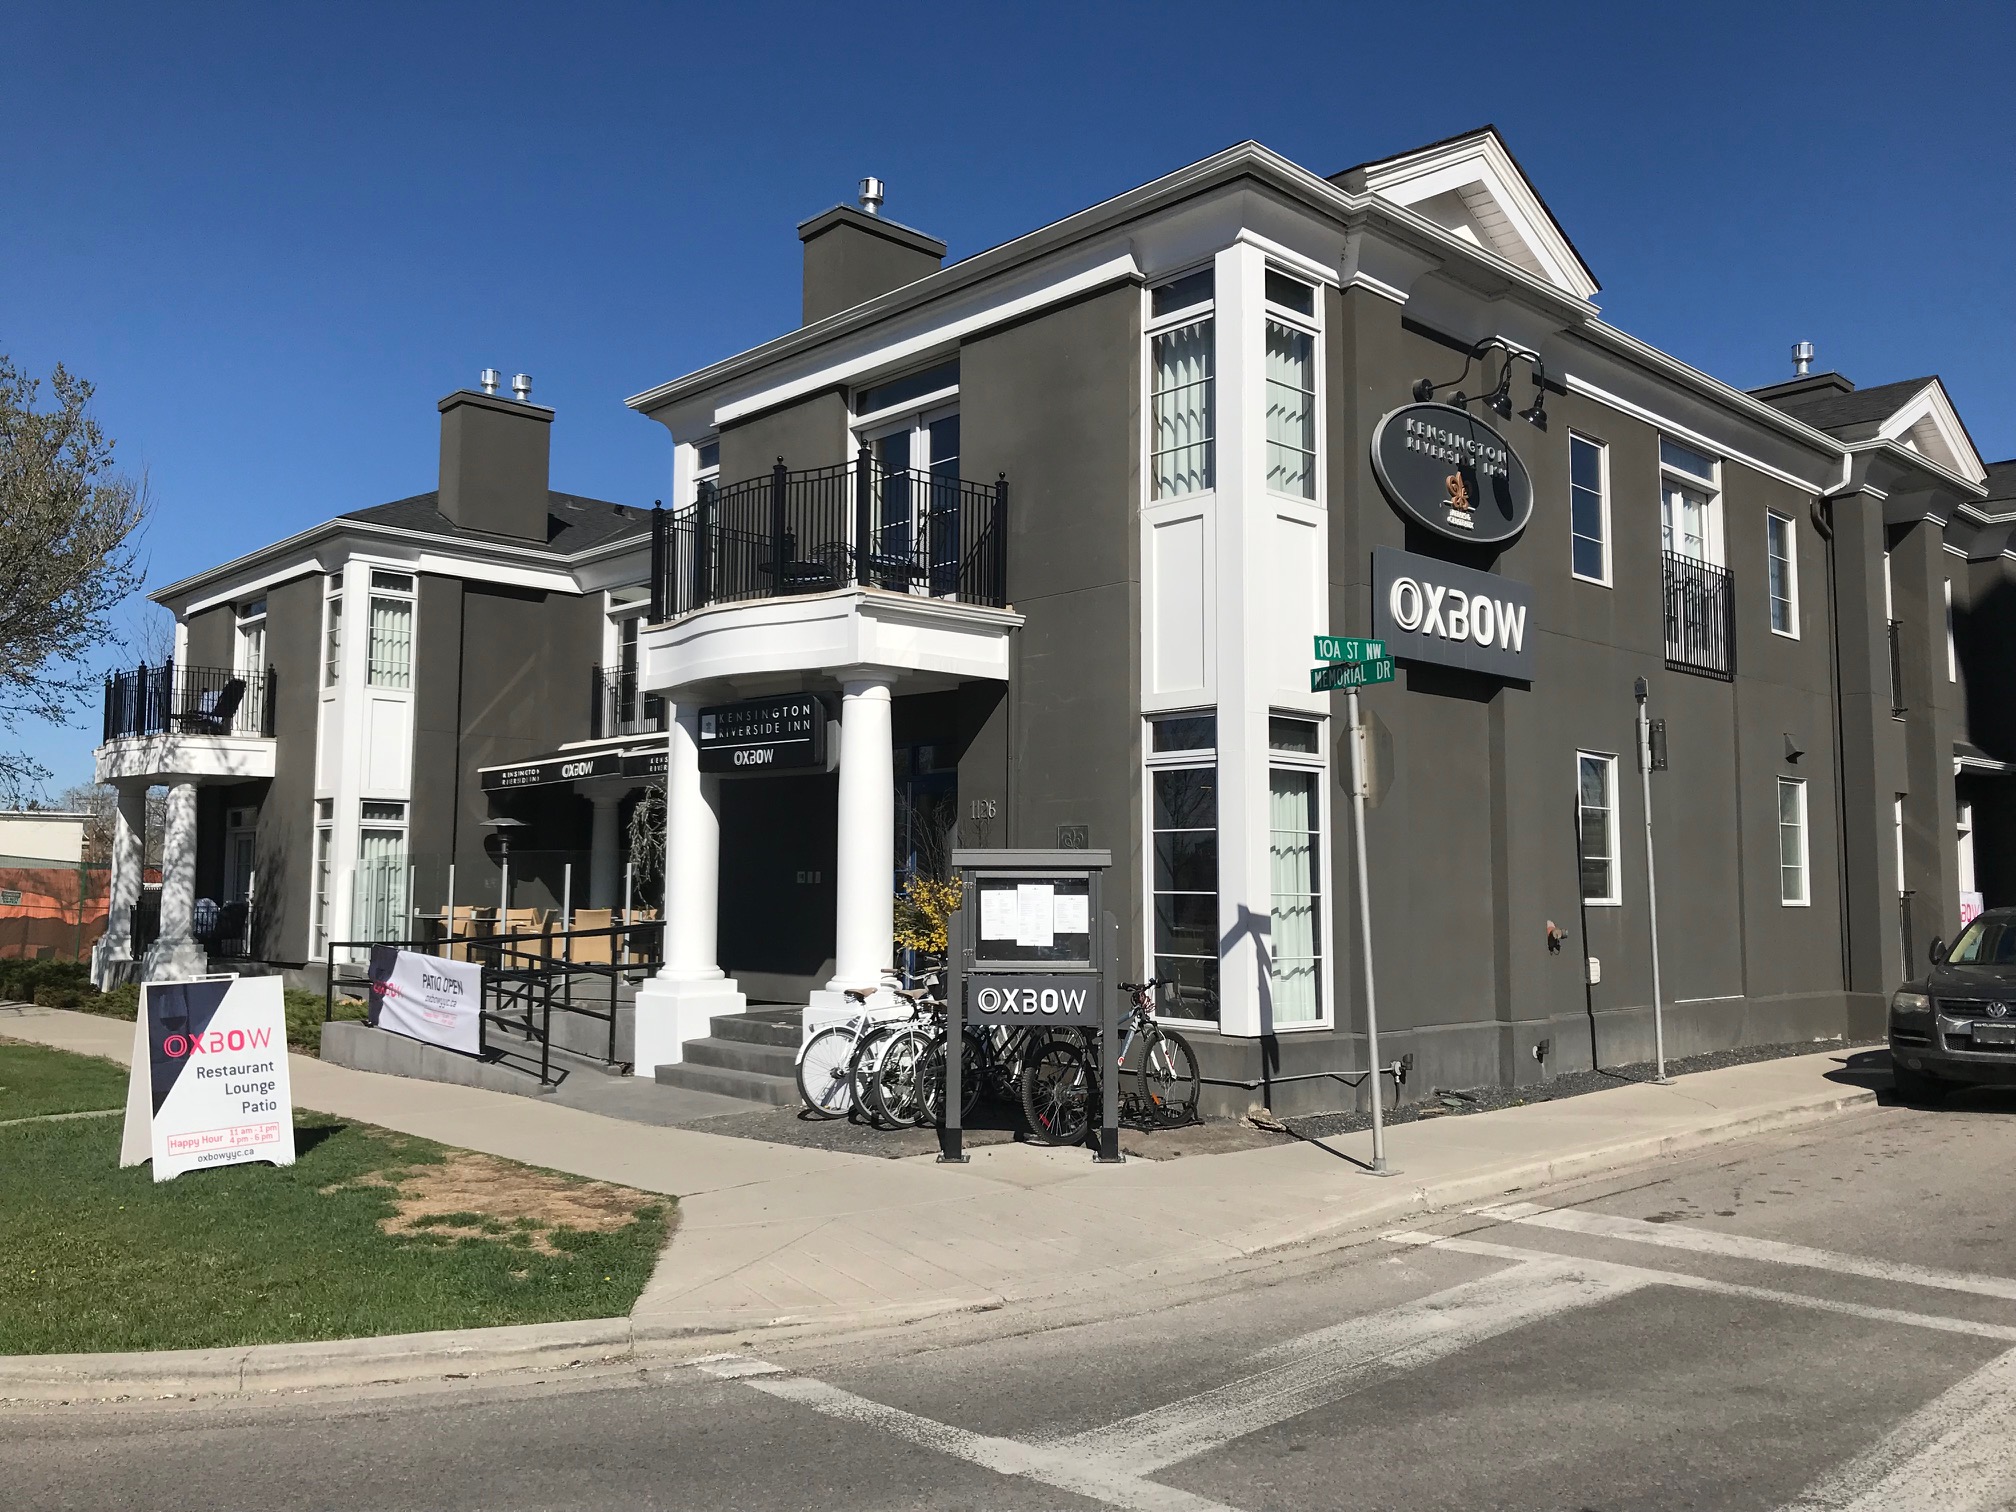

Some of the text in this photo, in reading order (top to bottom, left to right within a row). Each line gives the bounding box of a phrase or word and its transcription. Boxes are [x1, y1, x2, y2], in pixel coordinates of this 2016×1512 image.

[1406, 418, 1507, 463] KENSINGTON
[1390, 576, 1526, 654] OXBOW
[1318, 639, 1381, 660] 10A ST NW
[1314, 660, 1390, 689] MEMORIAL DR
[719, 704, 810, 724] KENSINGTON
[719, 719, 810, 738] RIVERSIDE INN
[734, 748, 774, 766] OXBOW
[561, 760, 594, 778] OXBOW
[969, 799, 996, 819] 1126
[422, 973, 464, 995] PATIO OPEN
[977, 987, 1087, 1015] OXBOW
[163, 1027, 271, 1058] OXBOW
[196, 1061, 274, 1079] Restaurant
[225, 1081, 275, 1096] Lounge
[242, 1099, 277, 1113] Patio
[230, 1128, 239, 1136] 11
[265, 1125, 277, 1133] pm
[236, 1136, 249, 1145] pm
[261, 1133, 273, 1142] pm
[170, 1134, 223, 1149] Happy Hour
[197, 1148, 254, 1162] oxbowyyc.ca
